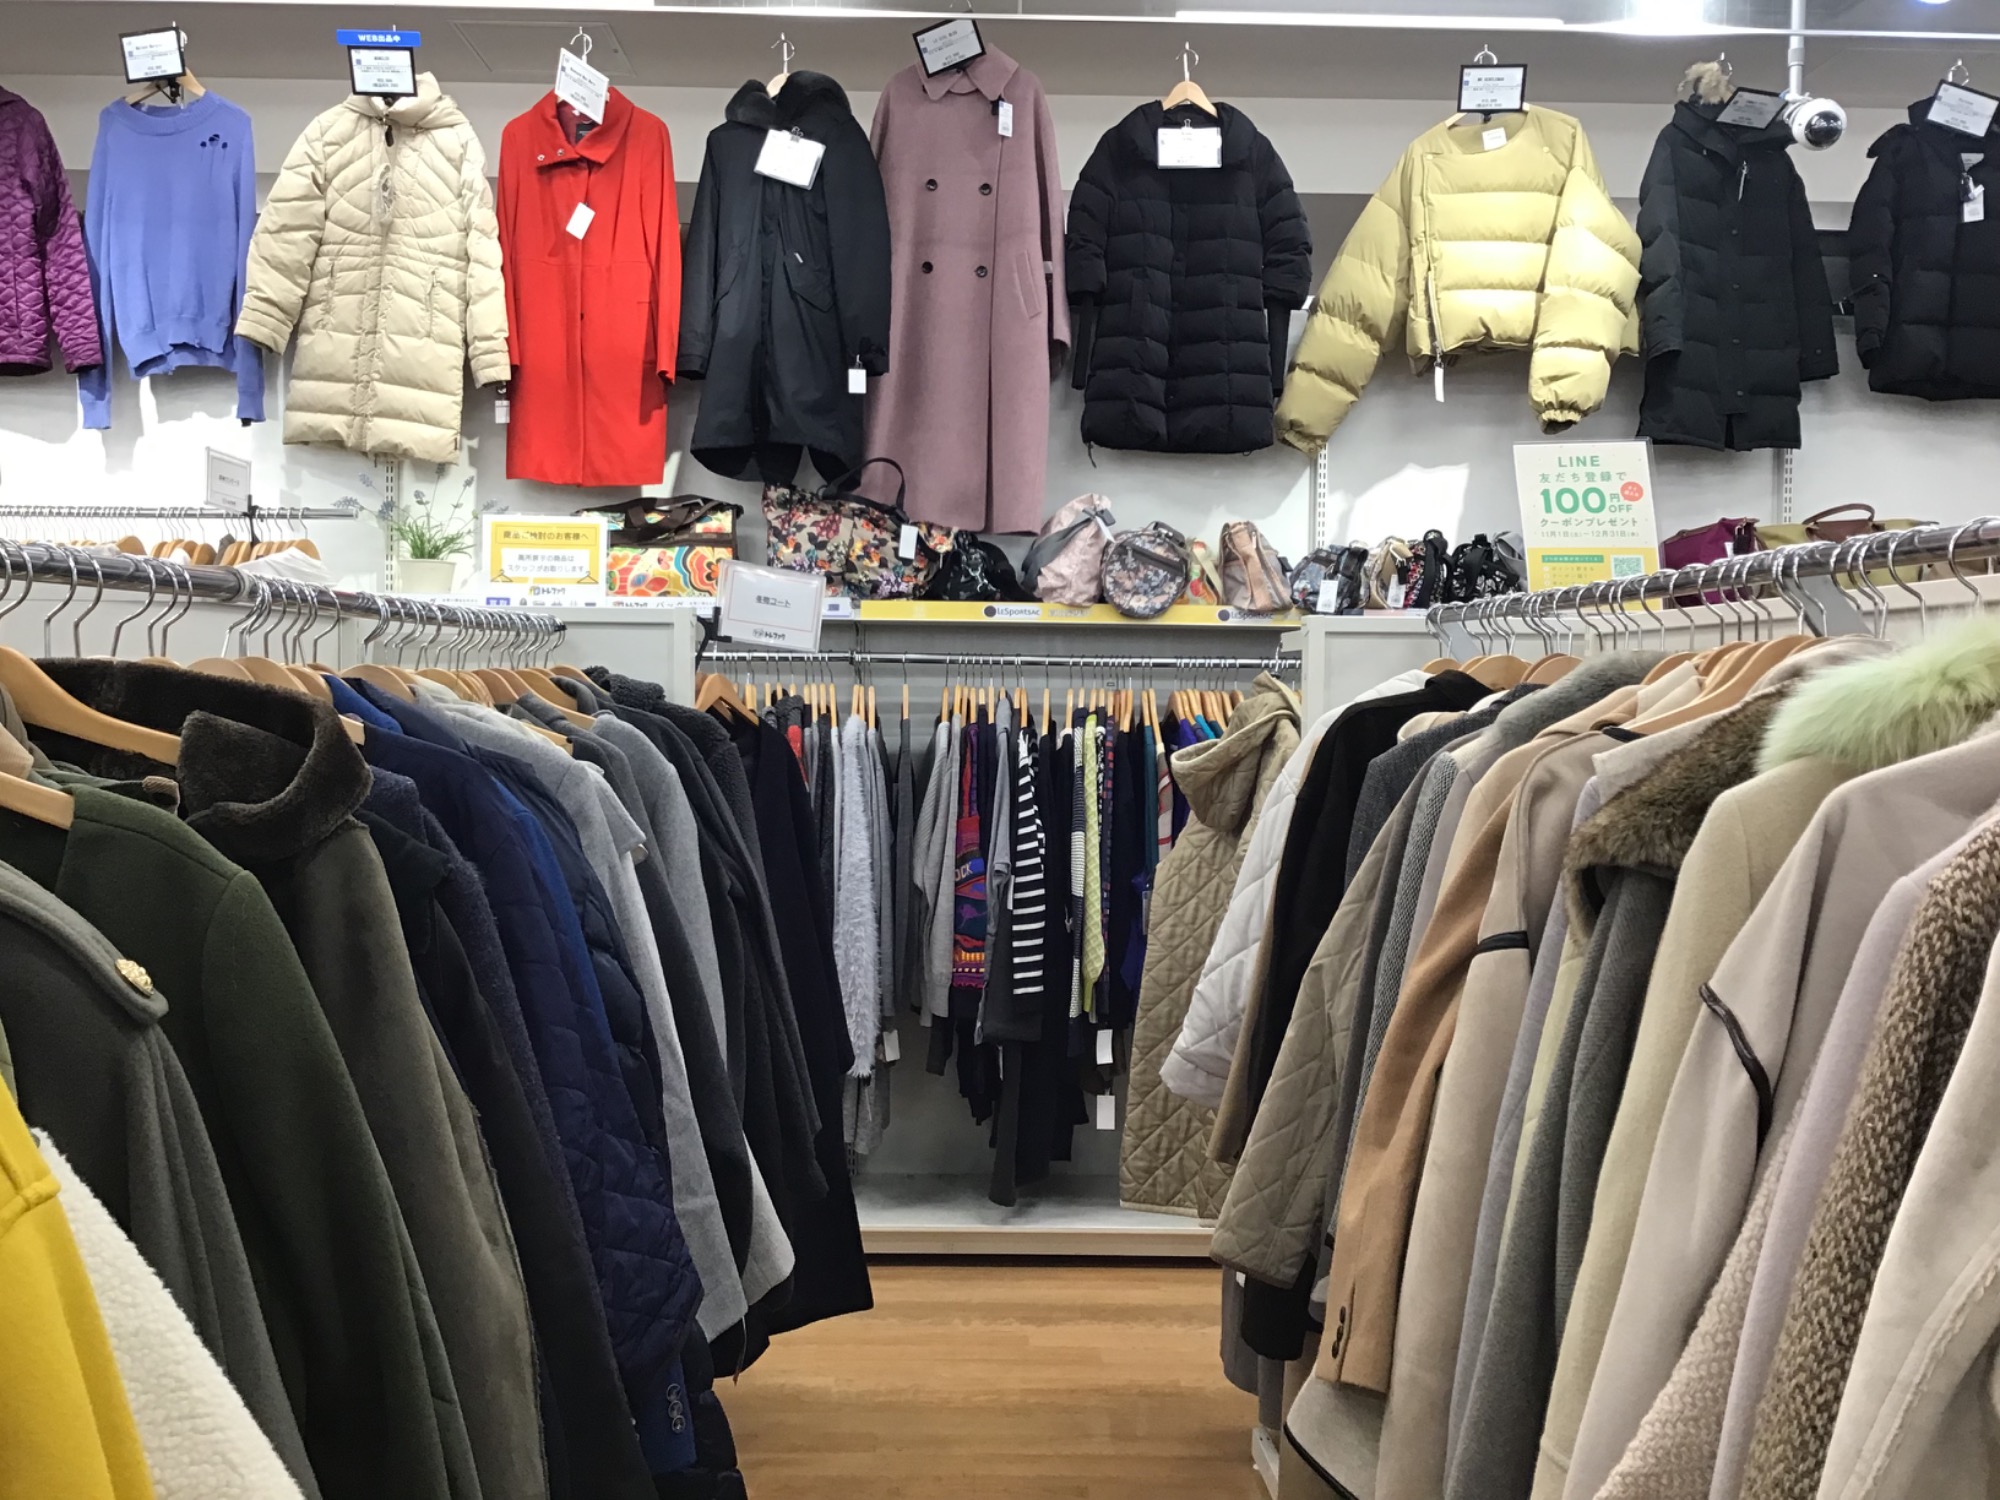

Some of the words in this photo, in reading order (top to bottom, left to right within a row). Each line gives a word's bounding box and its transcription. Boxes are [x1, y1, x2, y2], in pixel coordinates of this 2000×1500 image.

[358, 34, 401, 43] WEB出品中
[1558, 455, 1601, 468] LINE
[1539, 471, 1628, 483] 友だち登録で
[1609, 504, 1633, 514] OFF
[1540, 517, 1638, 528] クーポンプレゼント
